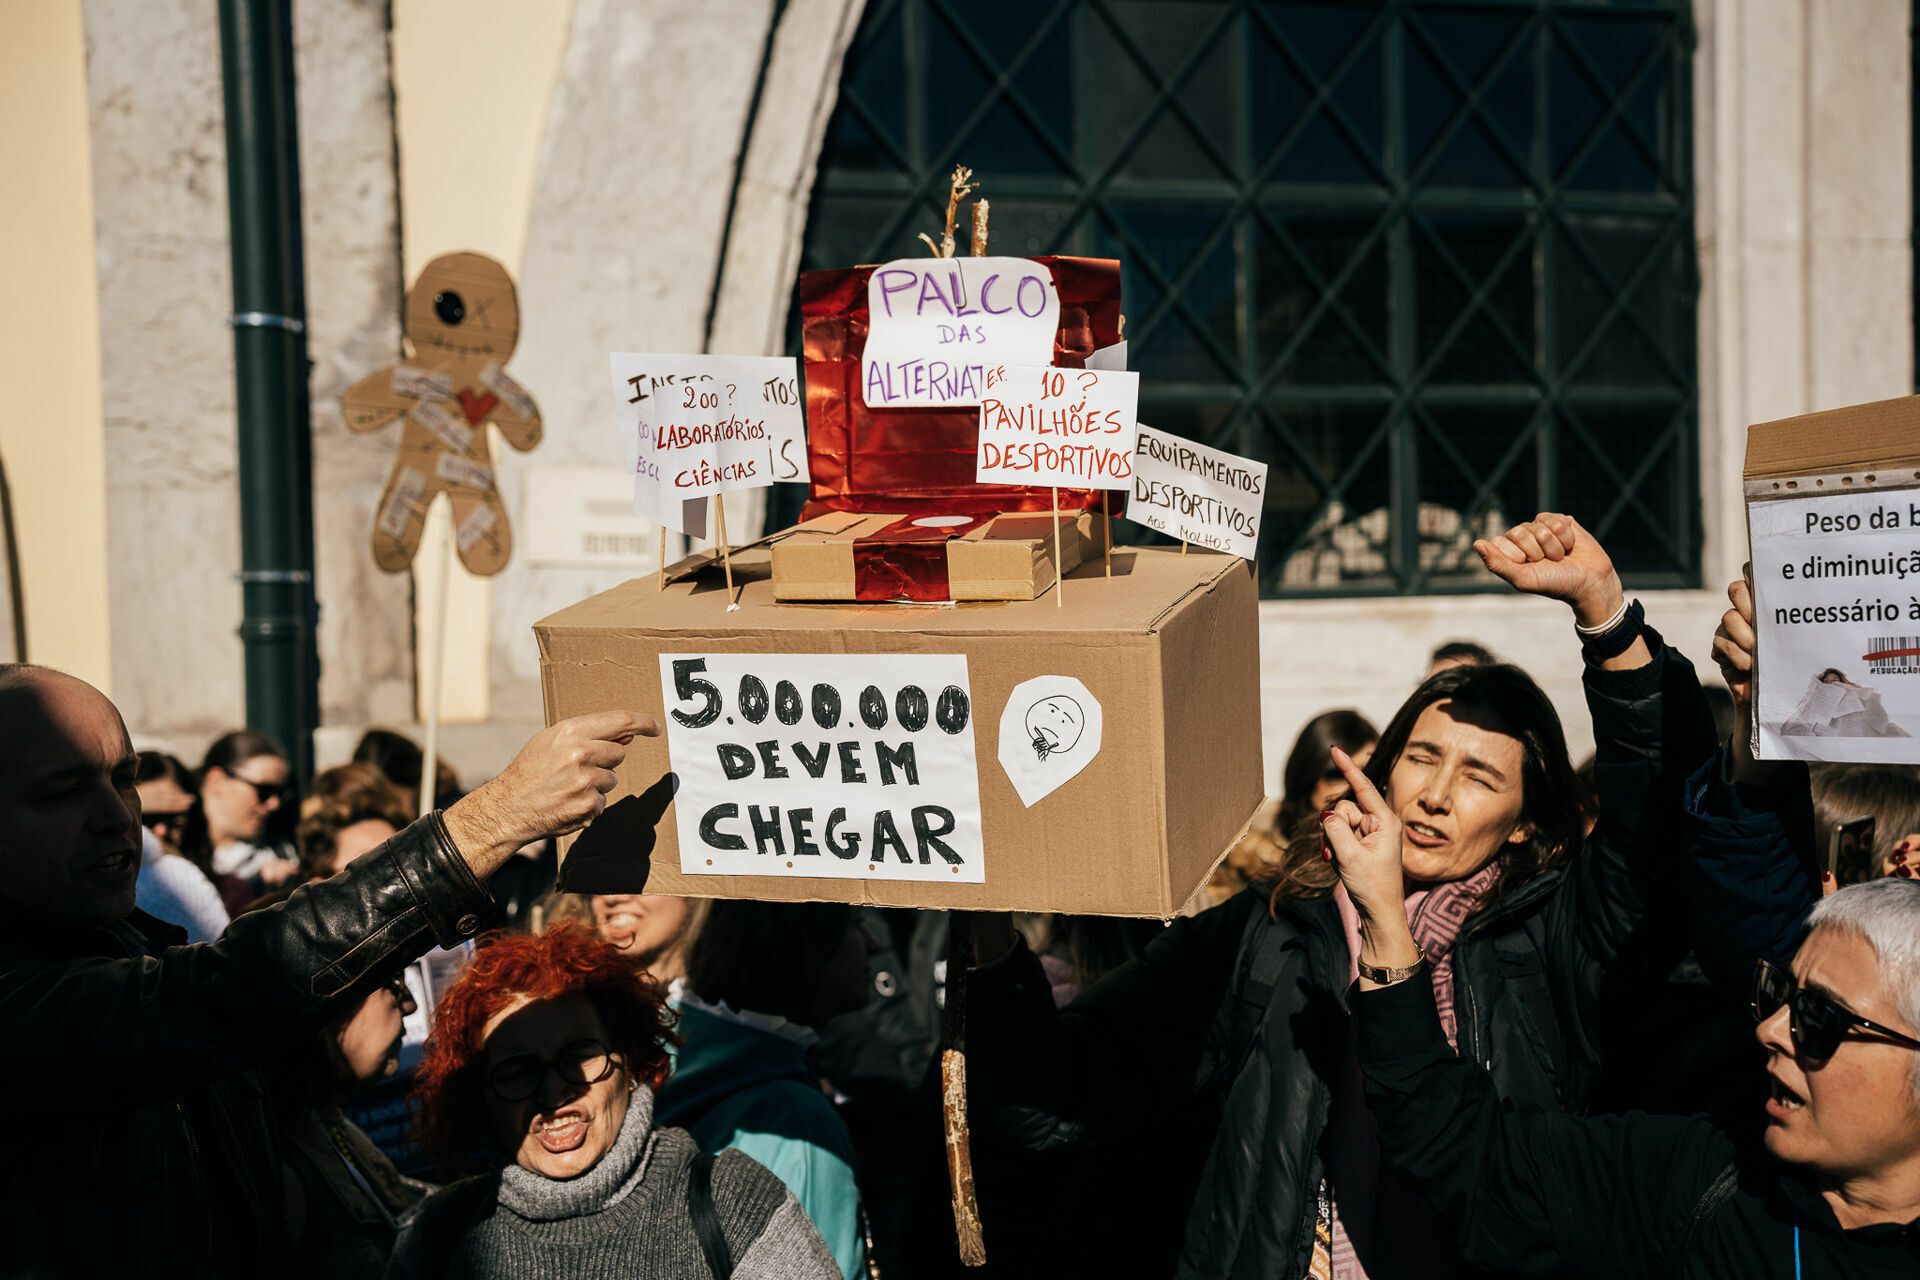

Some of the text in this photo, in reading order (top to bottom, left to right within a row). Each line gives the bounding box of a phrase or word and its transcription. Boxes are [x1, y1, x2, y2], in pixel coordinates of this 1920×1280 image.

[876, 269, 1047, 318] PALCO
[937, 324, 987, 345] DAS
[682, 385, 719, 409] 200
[1040, 370, 1065, 400] 10
[1146, 515, 1232, 551] AOS MOLHOS
[1805, 512, 1861, 534] Peso
[1869, 505, 1900, 530] da
[1782, 563, 1795, 580] e
[1775, 598, 1900, 625] necessário
[670, 657, 970, 735] 5.000.000
[716, 740, 920, 786] DEVEM
[699, 802, 964, 865] CHEGAR
